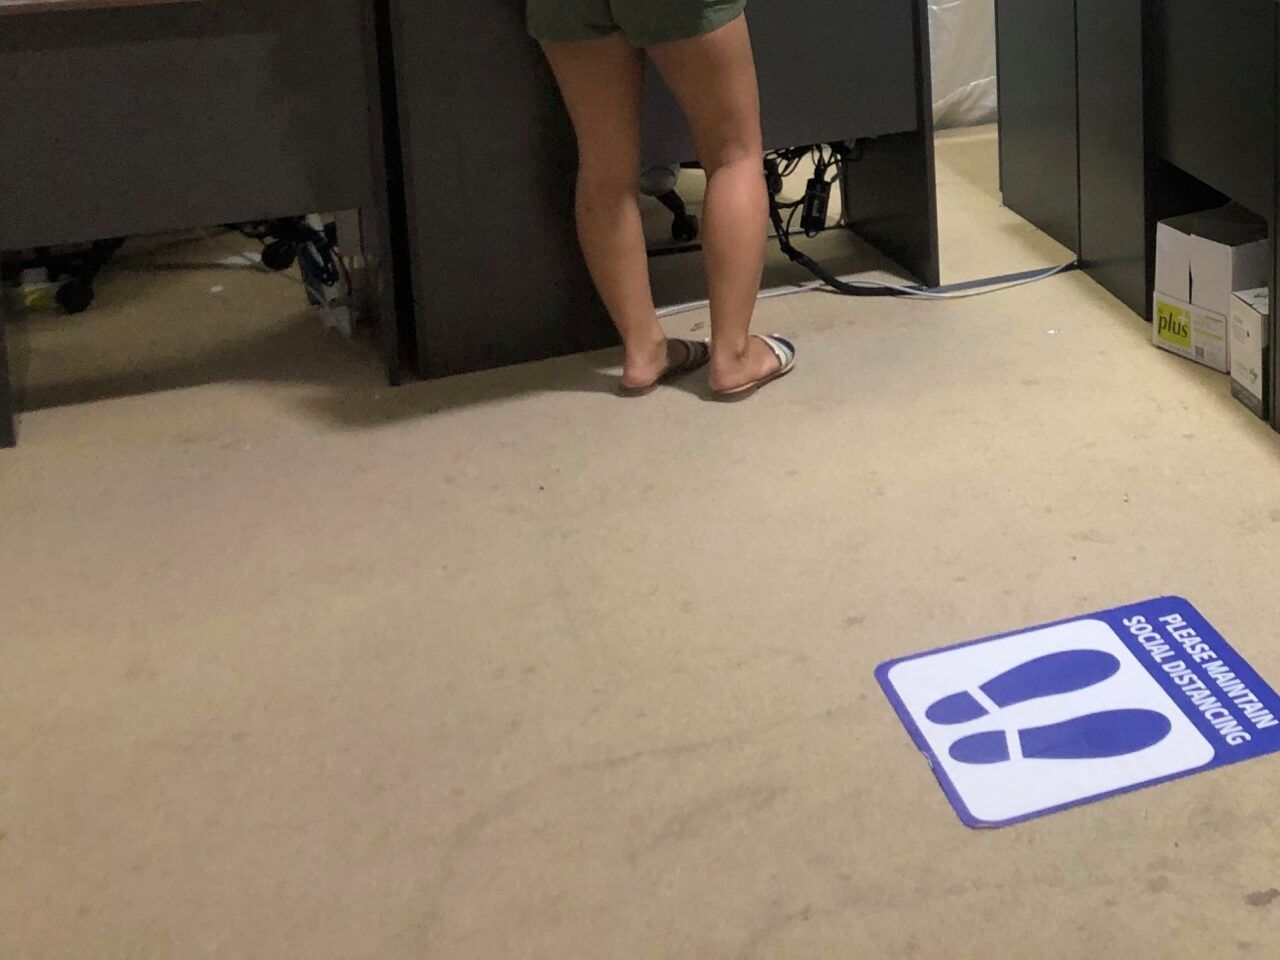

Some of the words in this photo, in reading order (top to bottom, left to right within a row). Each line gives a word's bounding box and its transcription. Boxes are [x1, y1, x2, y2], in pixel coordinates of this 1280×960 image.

[1157, 312, 1188, 338] plus
[1122, 614, 1174, 671] SOCIAL
[1161, 662, 1252, 746] DISTANCING
[1158, 613, 1212, 664] PLEASE
[1203, 658, 1279, 730] MAINTAIN
